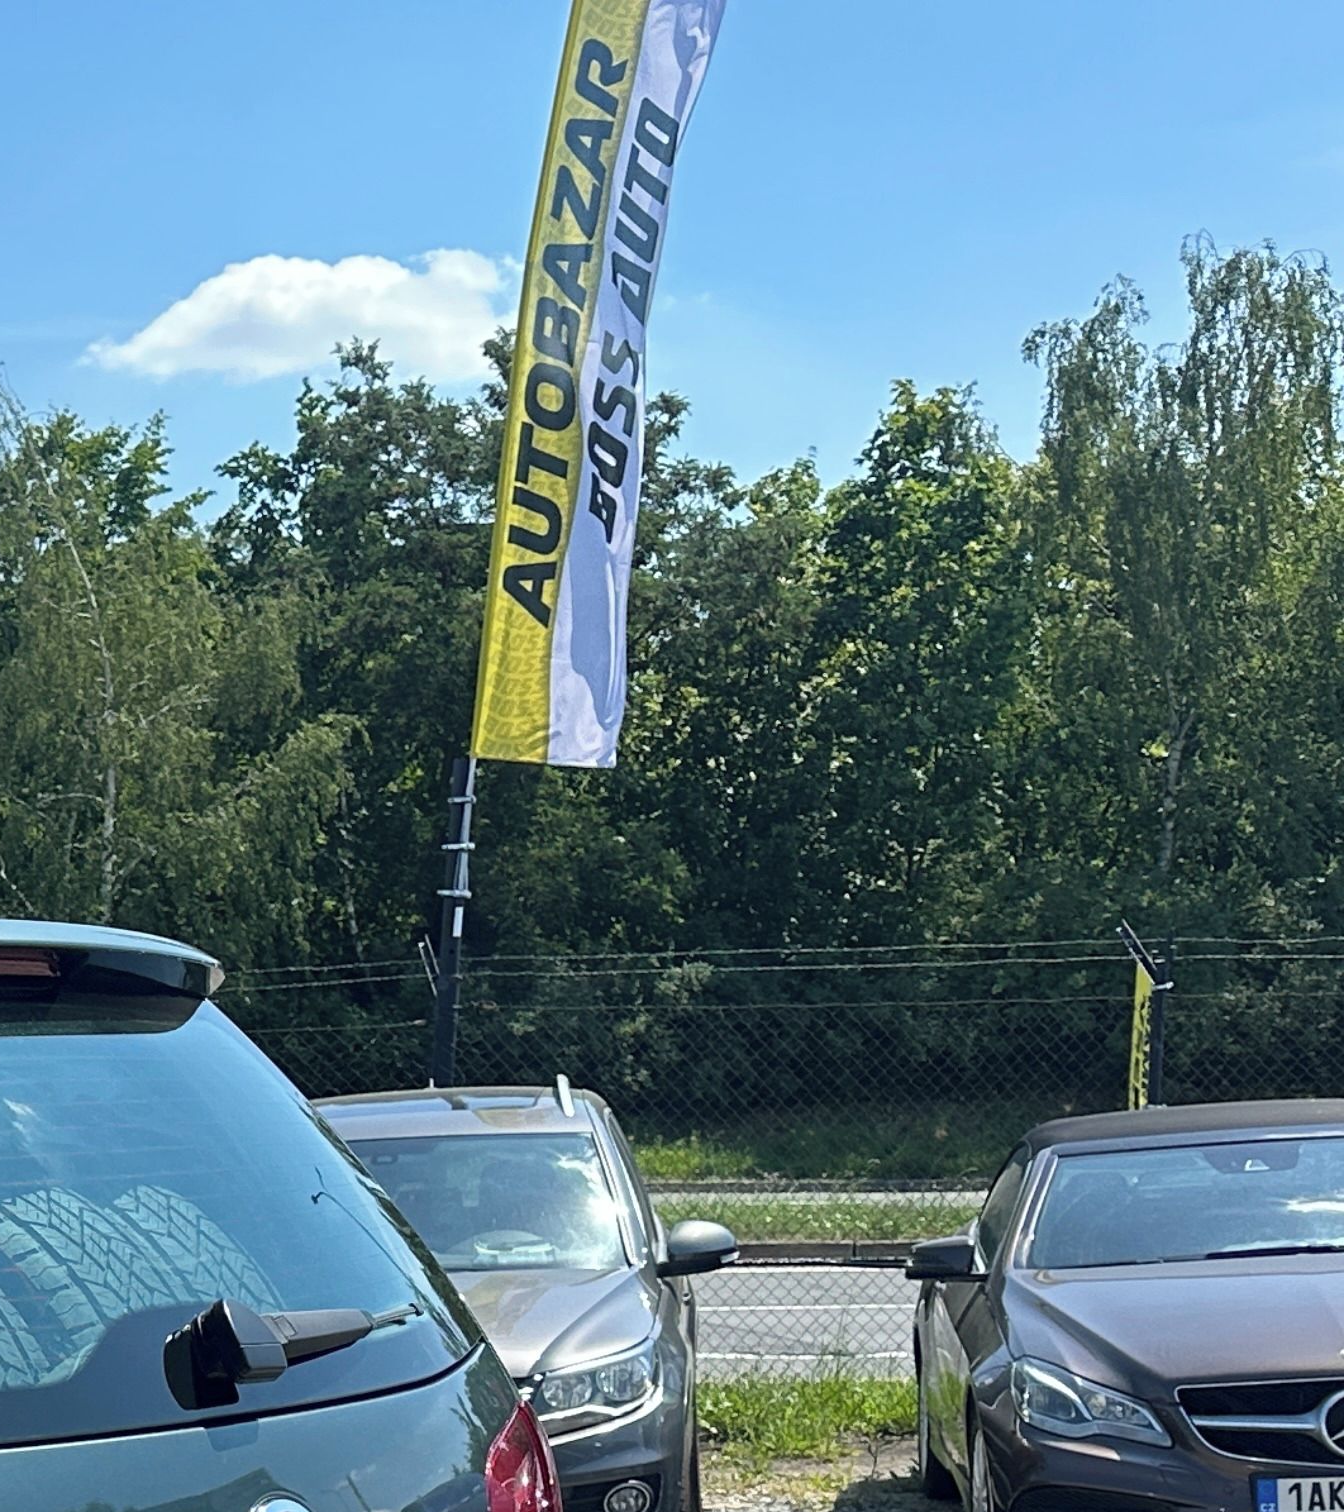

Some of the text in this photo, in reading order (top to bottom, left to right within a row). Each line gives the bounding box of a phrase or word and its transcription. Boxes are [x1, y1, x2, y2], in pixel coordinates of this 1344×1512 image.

[502, 38, 629, 629] AUTOBAZAR
[588, 97, 680, 545] BOSS AUTO
[1288, 1481, 1344, 1511] 1AK
